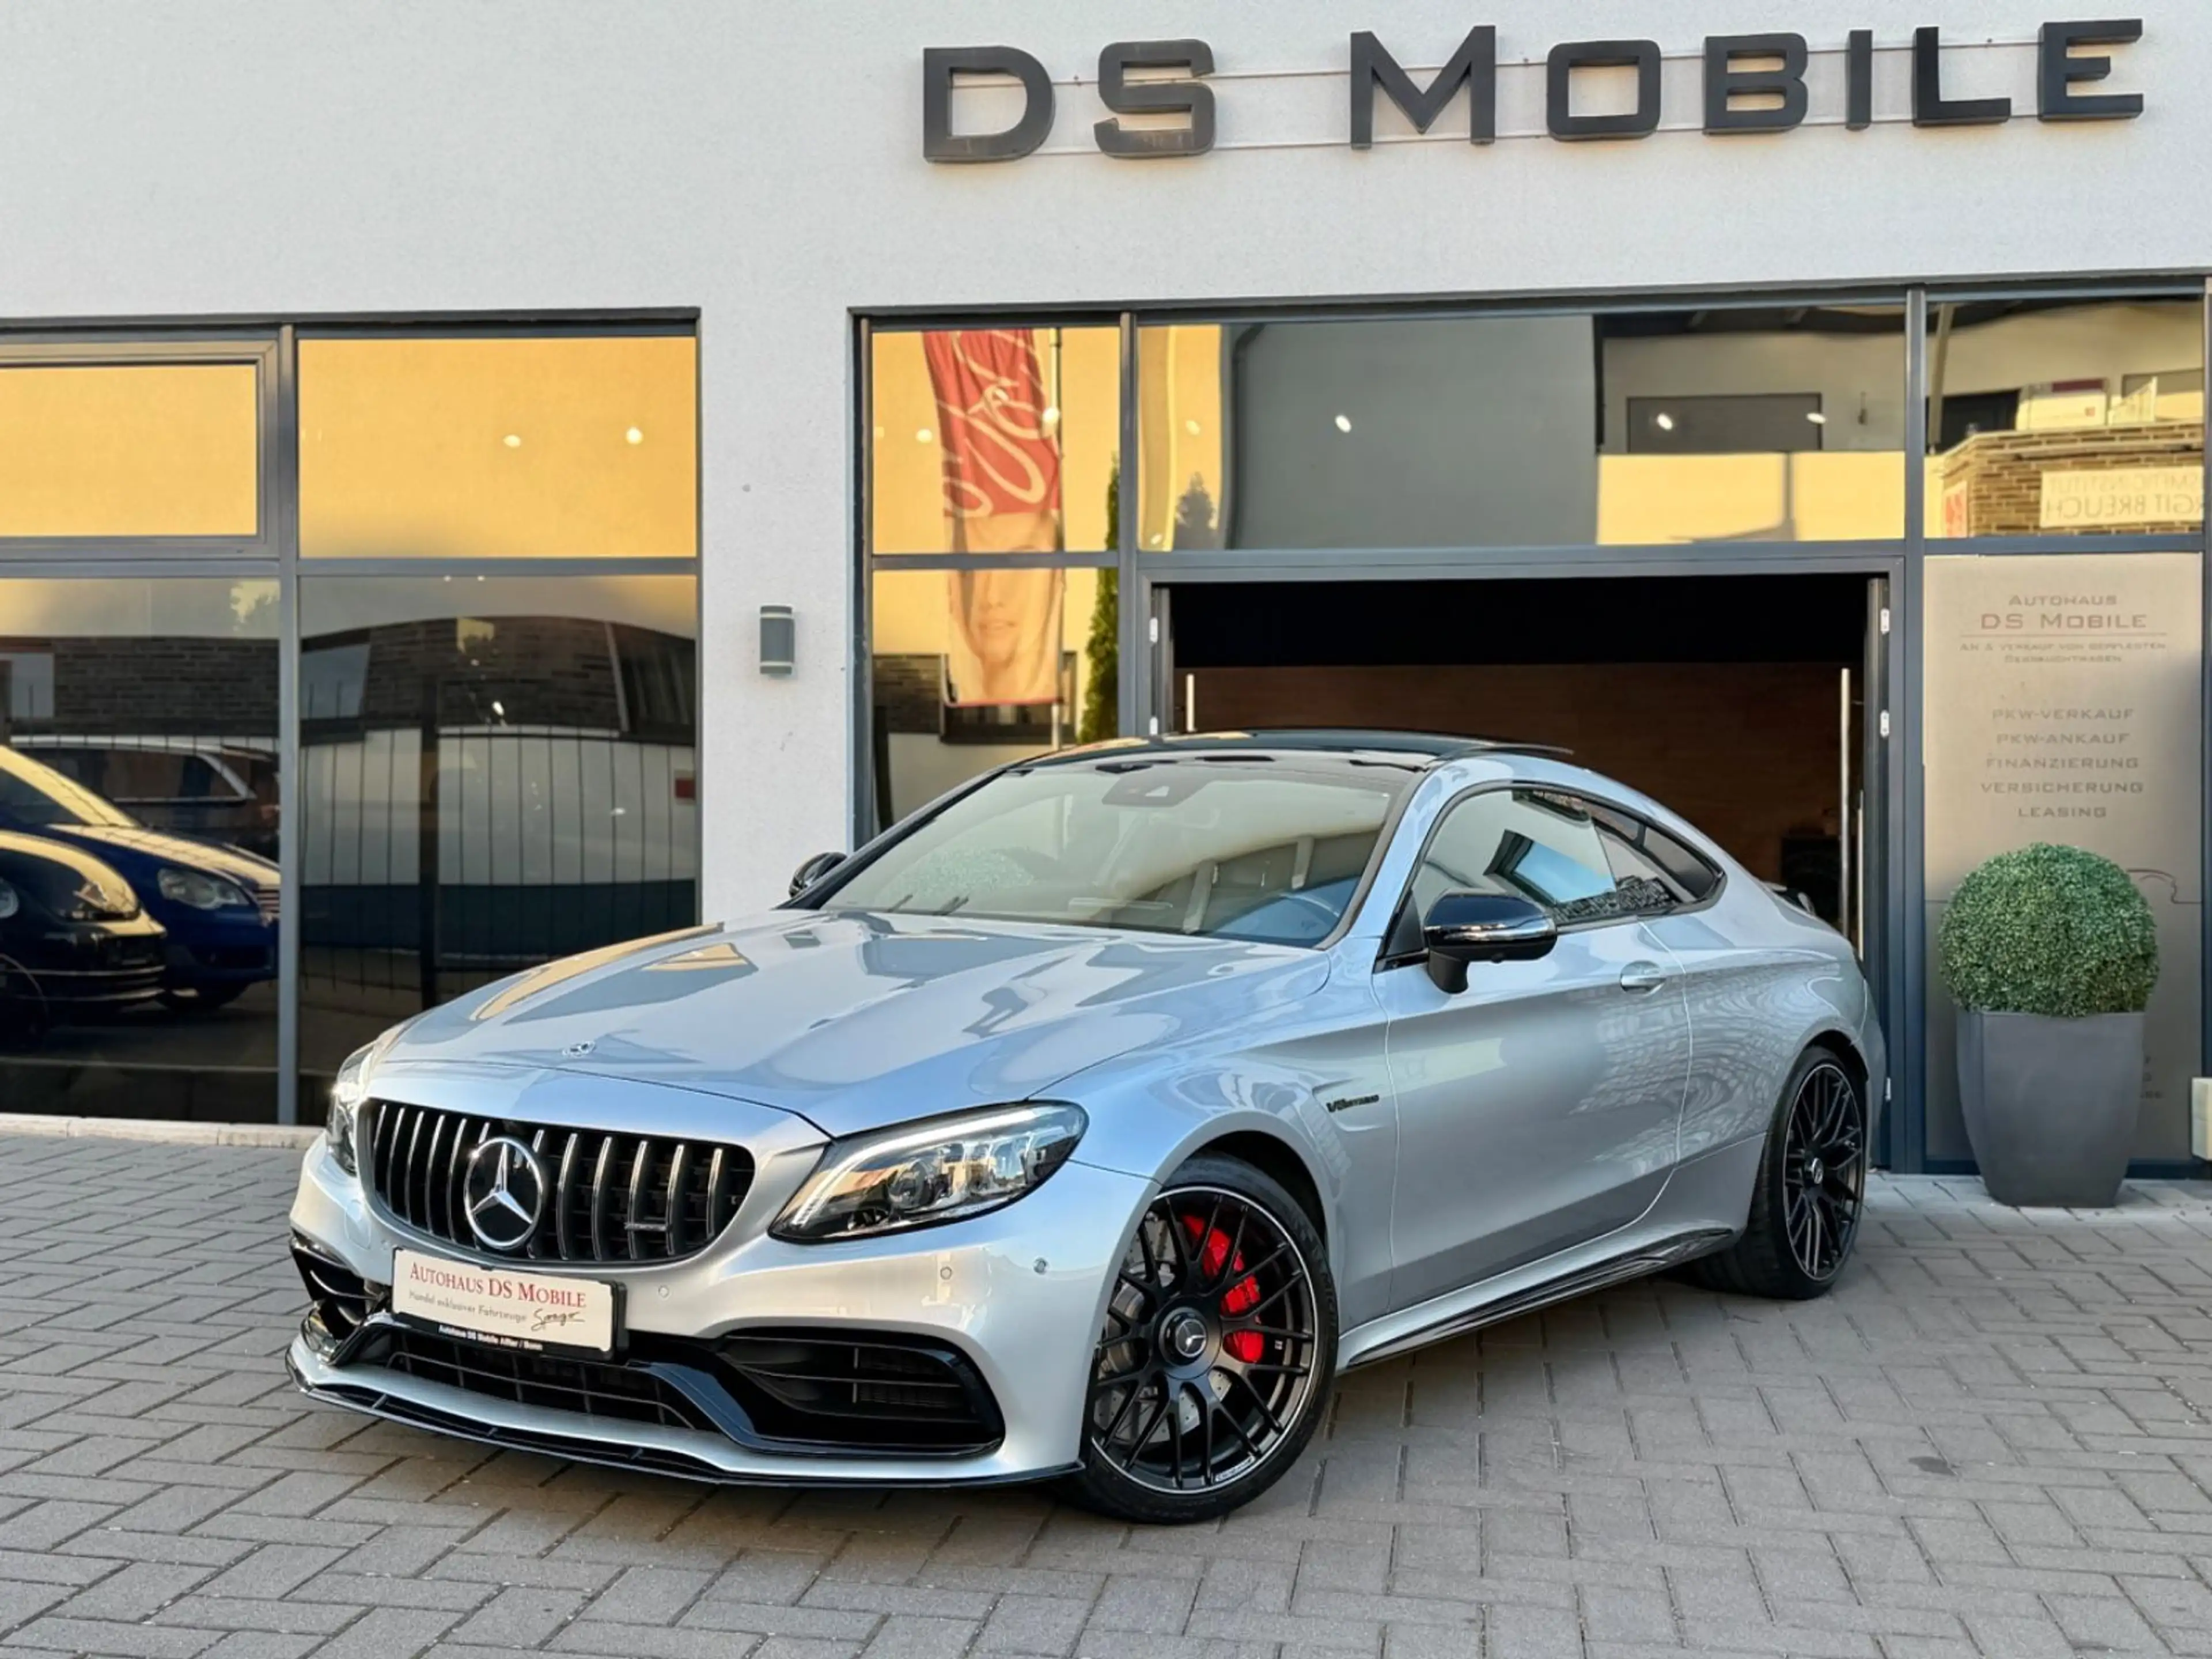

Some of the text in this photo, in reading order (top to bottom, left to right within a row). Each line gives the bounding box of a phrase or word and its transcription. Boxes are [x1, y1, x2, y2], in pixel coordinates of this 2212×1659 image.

[924, 19, 2144, 162] DS MOBILE
[2009, 595, 2118, 606] AUTOHAUS
[1980, 613, 2147, 630] DS MOBILE
[1992, 709, 2134, 721] PKW-VERKAUF
[1996, 733, 2131, 745] PKW-ANKAUF
[1986, 757, 2139, 770] FINANZIERUNG
[1980, 782, 2145, 794] VERSICHERUNG
[2018, 807, 2108, 819] LEASING
[410, 1261, 587, 1308] AUTOHAUS DS MOBILE
